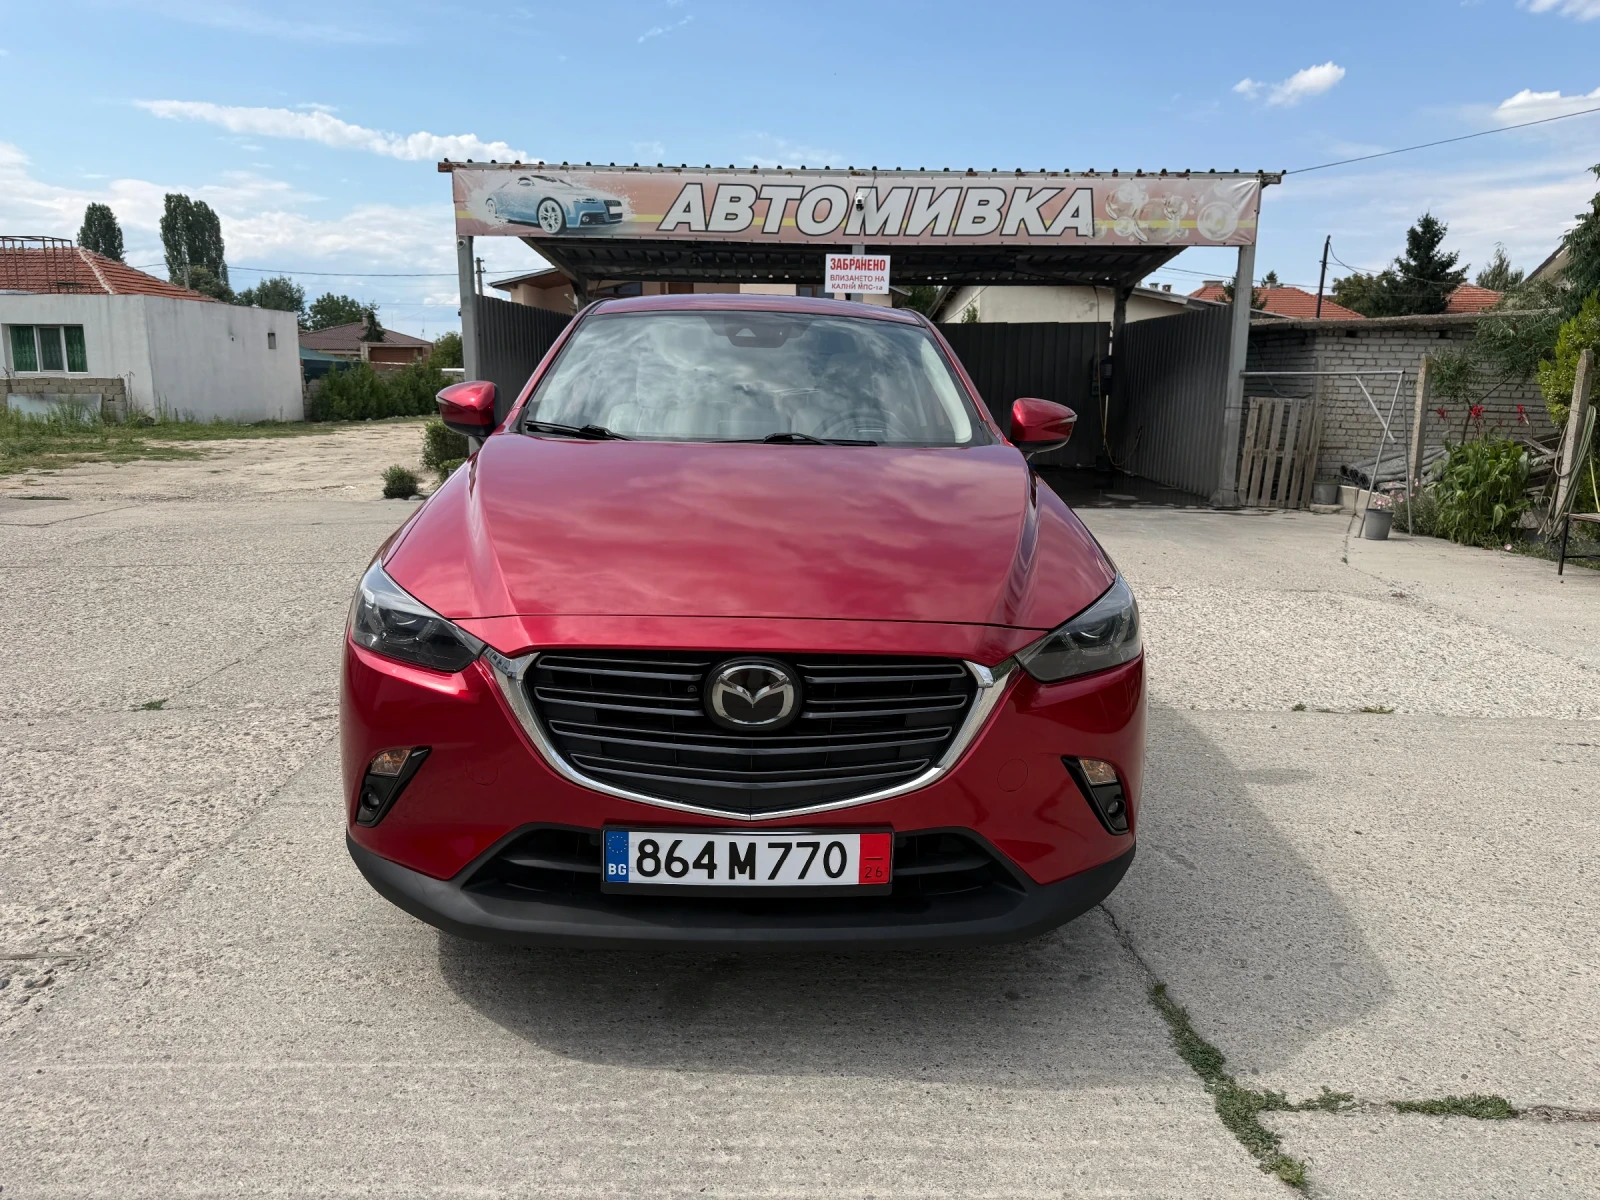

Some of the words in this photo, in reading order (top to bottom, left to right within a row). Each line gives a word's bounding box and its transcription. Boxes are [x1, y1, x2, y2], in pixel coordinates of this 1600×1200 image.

[656, 182, 1096, 237] АВТОМИВКА
[830, 257, 886, 271] ЗАБРАНЕНО
[830, 274, 873, 283] ВЛИЗАНЕТО
[874, 275, 885, 283] НА
[636, 838, 717, 880] 864
[767, 841, 848, 880] 770
[608, 863, 627, 876] BG
[864, 866, 883, 878] 26
